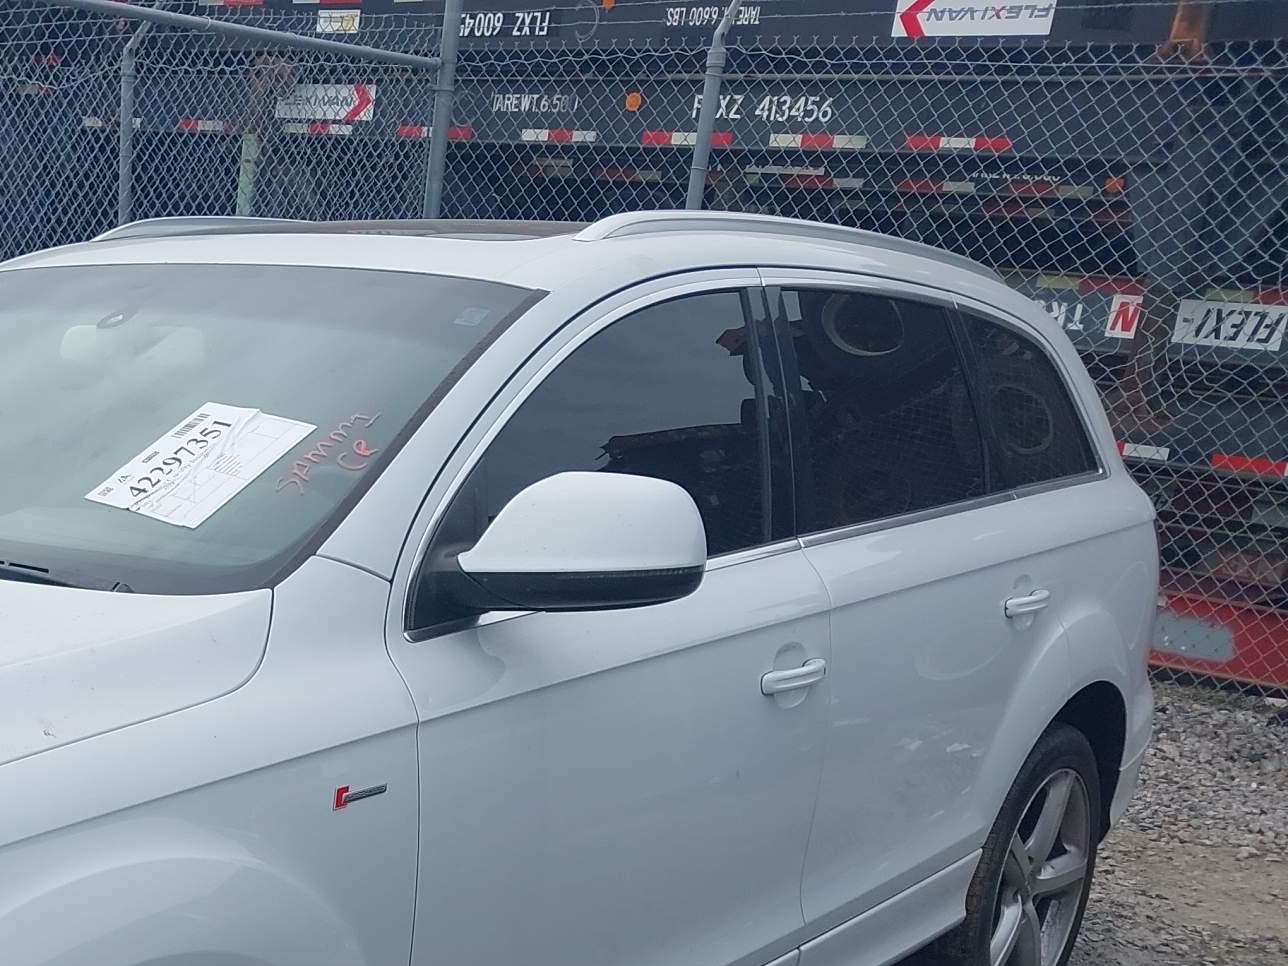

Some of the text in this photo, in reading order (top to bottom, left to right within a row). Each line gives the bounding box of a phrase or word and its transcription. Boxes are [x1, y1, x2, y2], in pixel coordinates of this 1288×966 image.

[512, 12, 550, 36] FLXZ
[737, 6, 761, 25] TARE
[692, 94, 833, 122] FXZ 413456
[1110, 301, 1143, 333] N
[129, 420, 232, 498] 42297351
